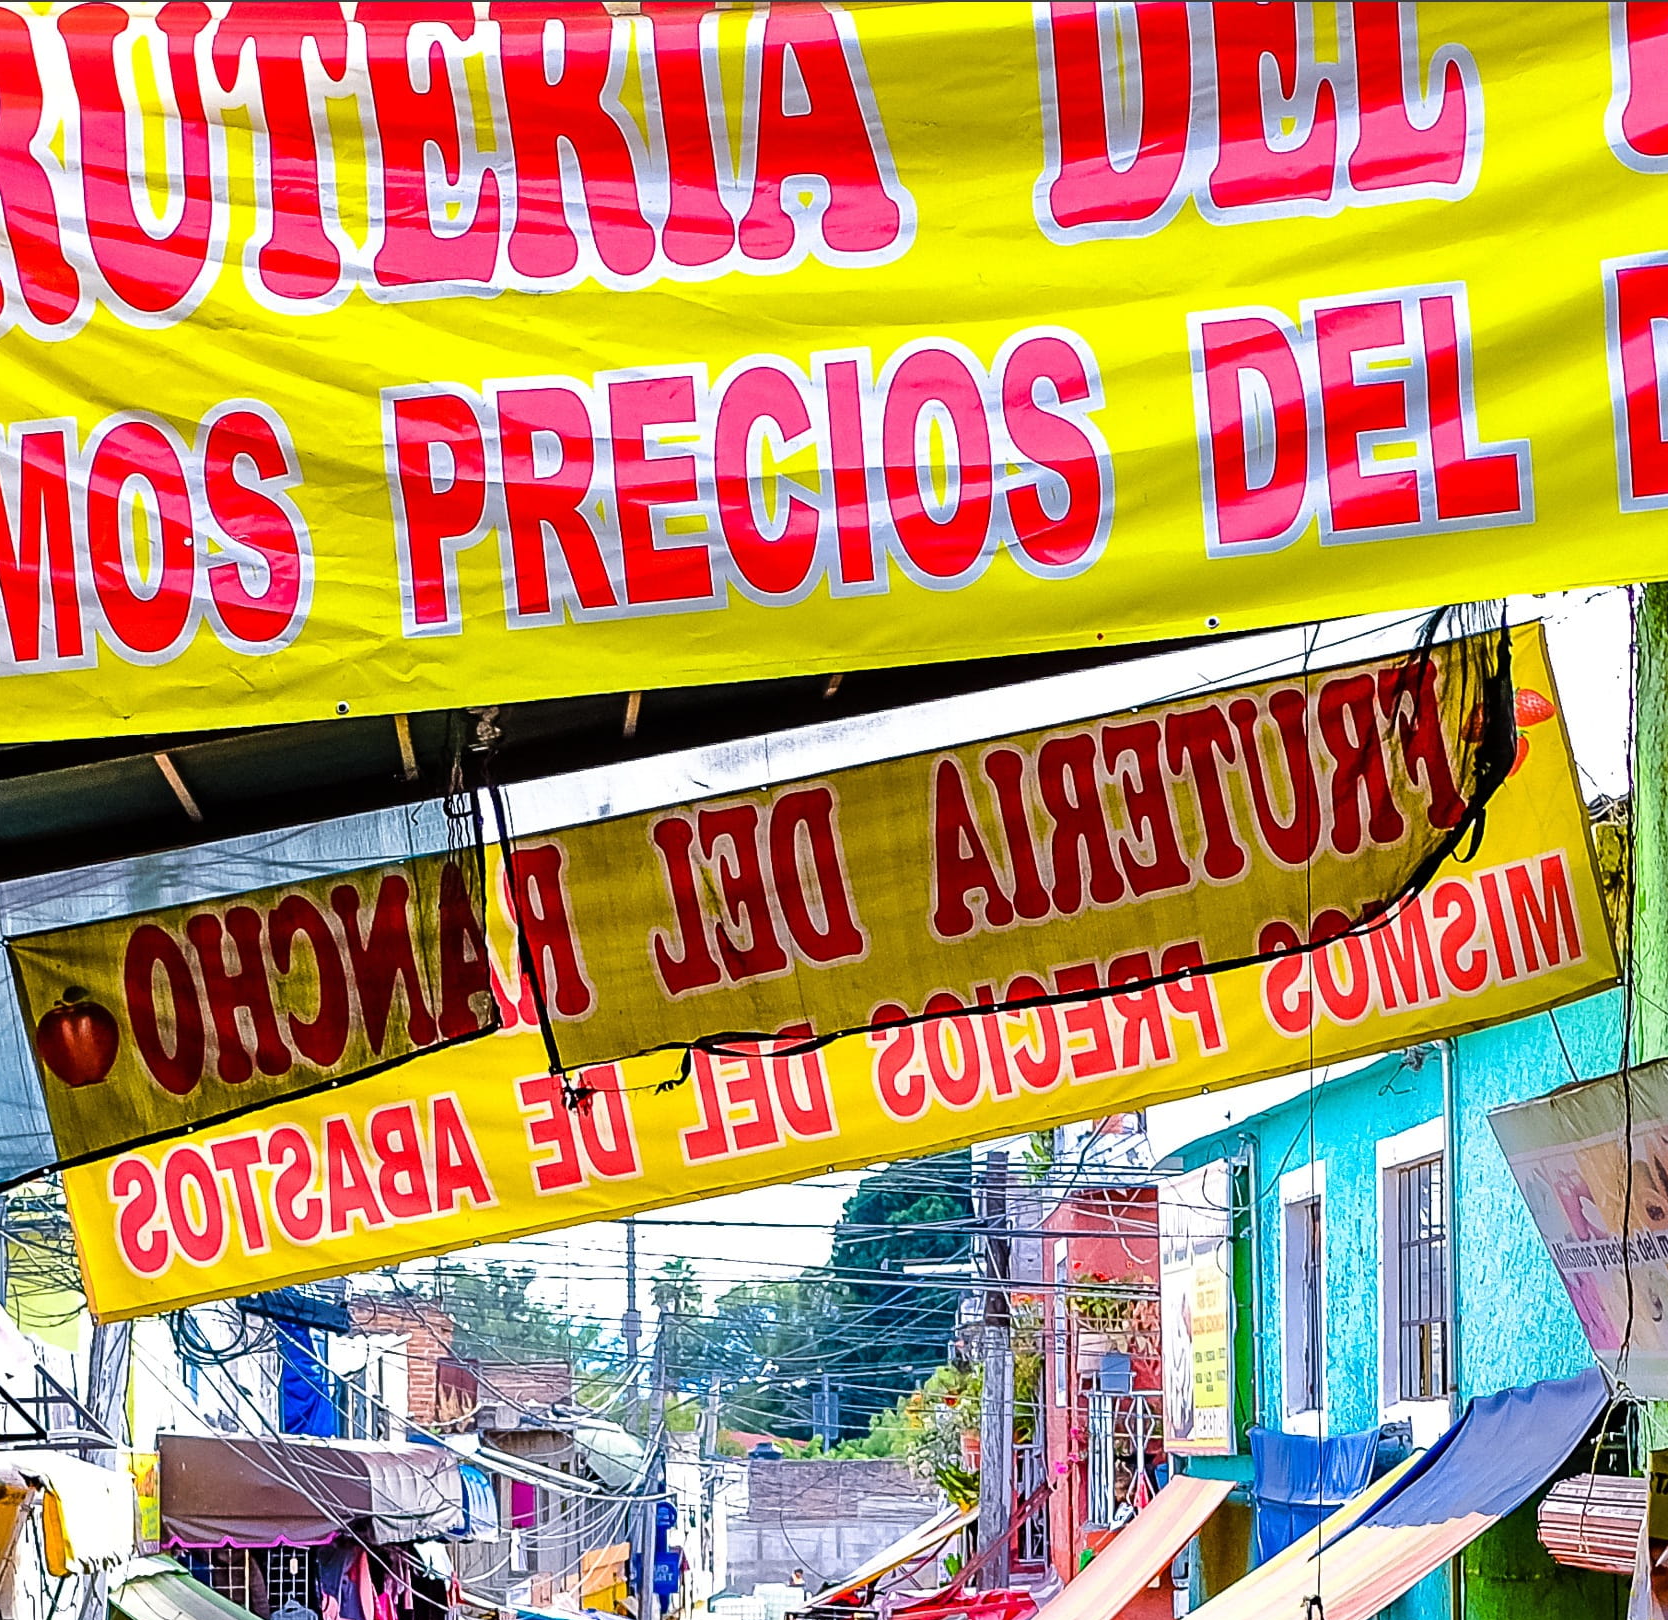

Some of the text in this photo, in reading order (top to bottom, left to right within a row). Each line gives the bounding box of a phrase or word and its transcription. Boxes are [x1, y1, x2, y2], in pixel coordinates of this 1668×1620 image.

[1037, 0, 1479, 242] DEL
[383, 326, 1113, 637] PRECIOS
[1189, 281, 1533, 559] DEL
[1551, 1242, 1598, 1270] Mismos
[1635, 1230, 1660, 1260] del
